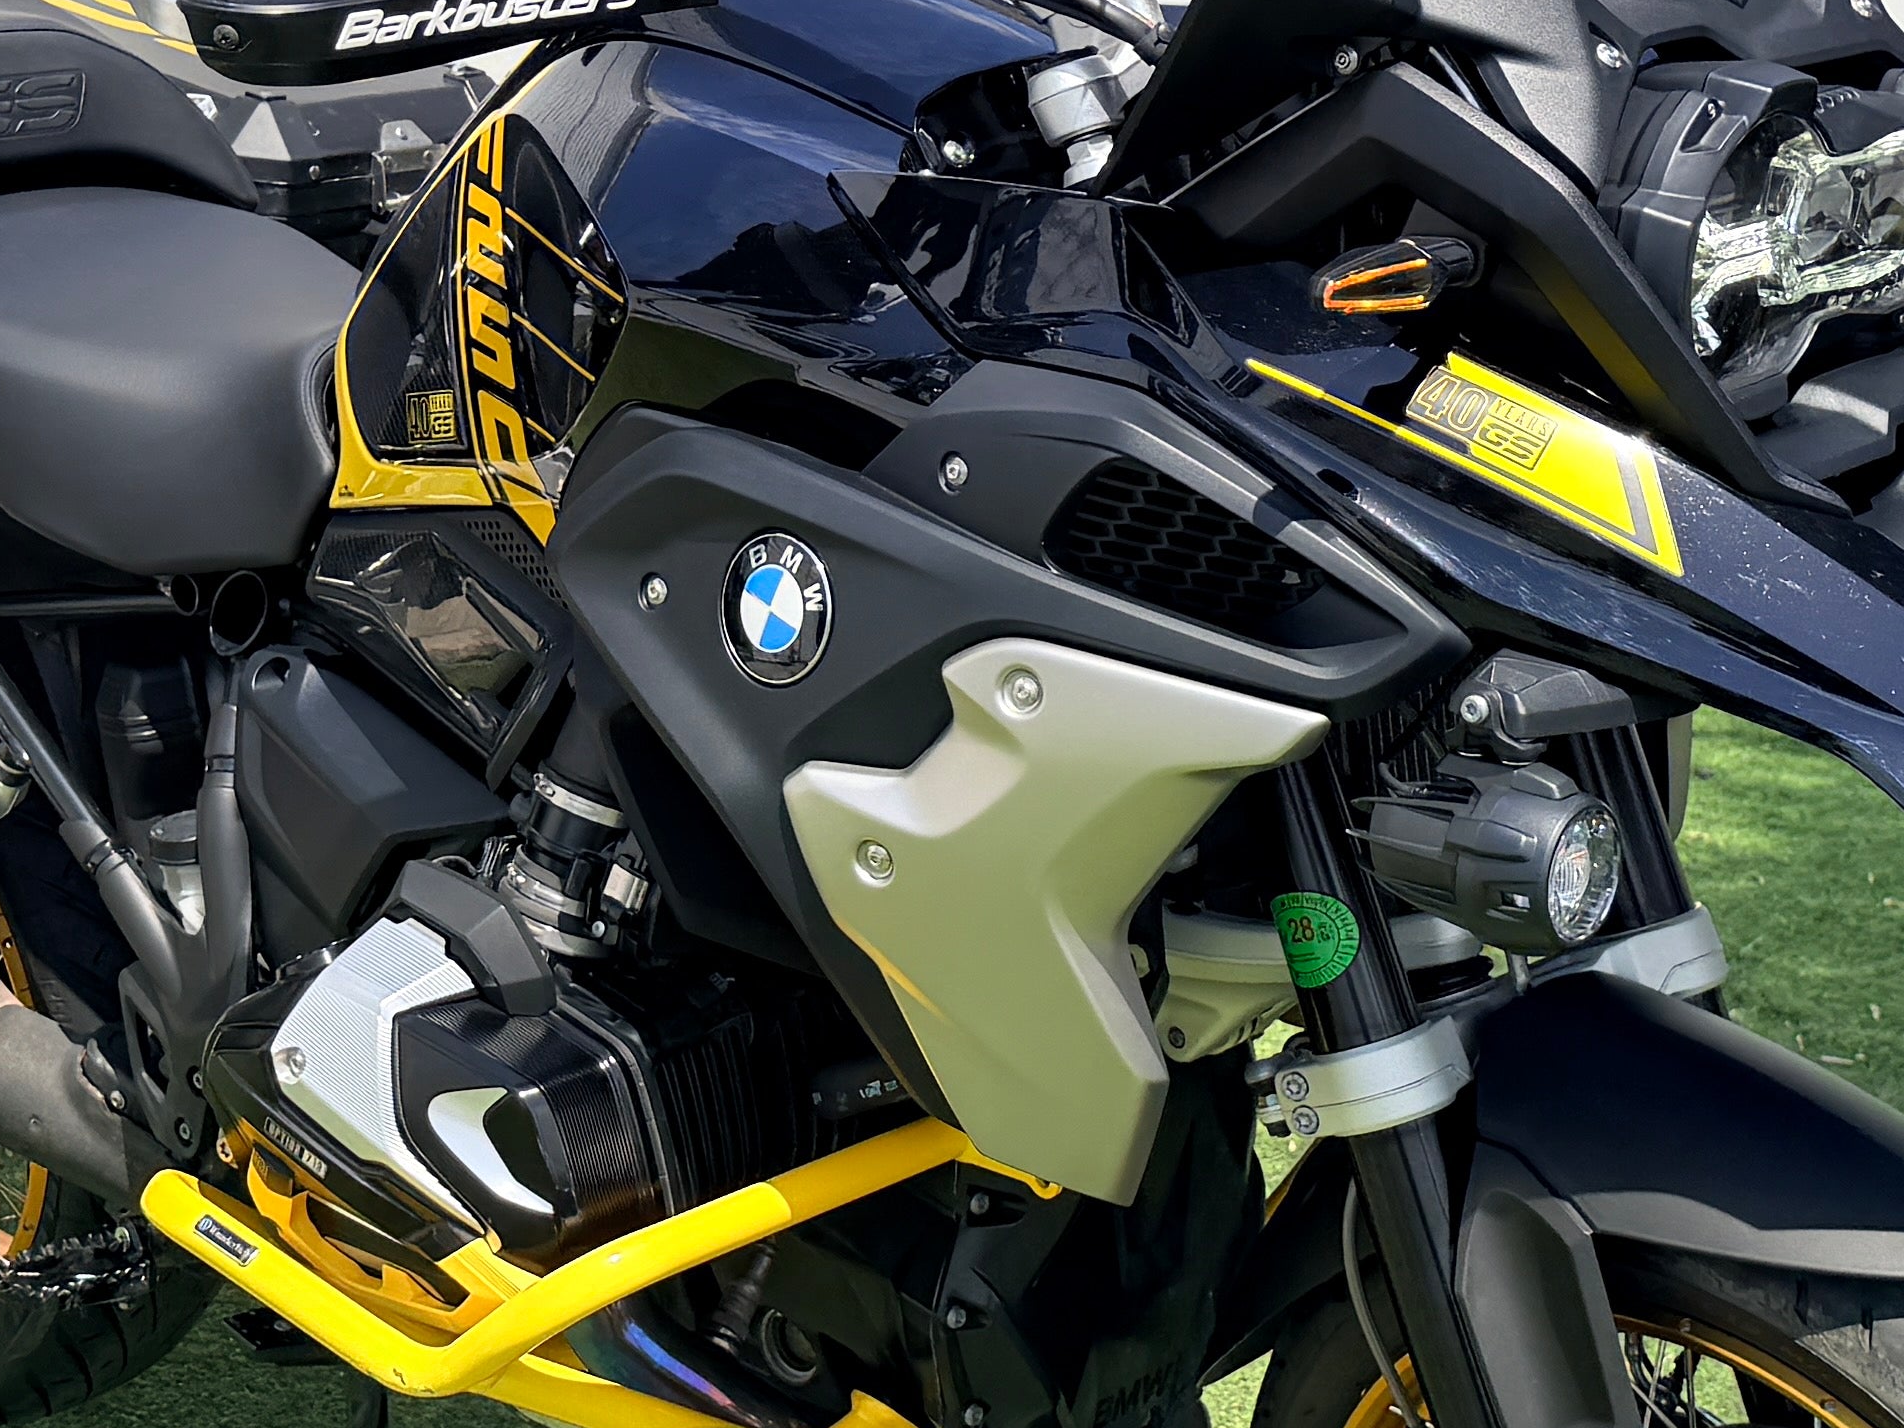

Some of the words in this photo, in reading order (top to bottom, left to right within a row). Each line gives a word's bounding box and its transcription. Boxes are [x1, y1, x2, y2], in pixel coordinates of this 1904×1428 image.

[1417, 374, 1489, 432] 40
[1494, 399, 1551, 437] YEARS
[1479, 422, 1542, 460] GS
[748, 543, 824, 612] BMW
